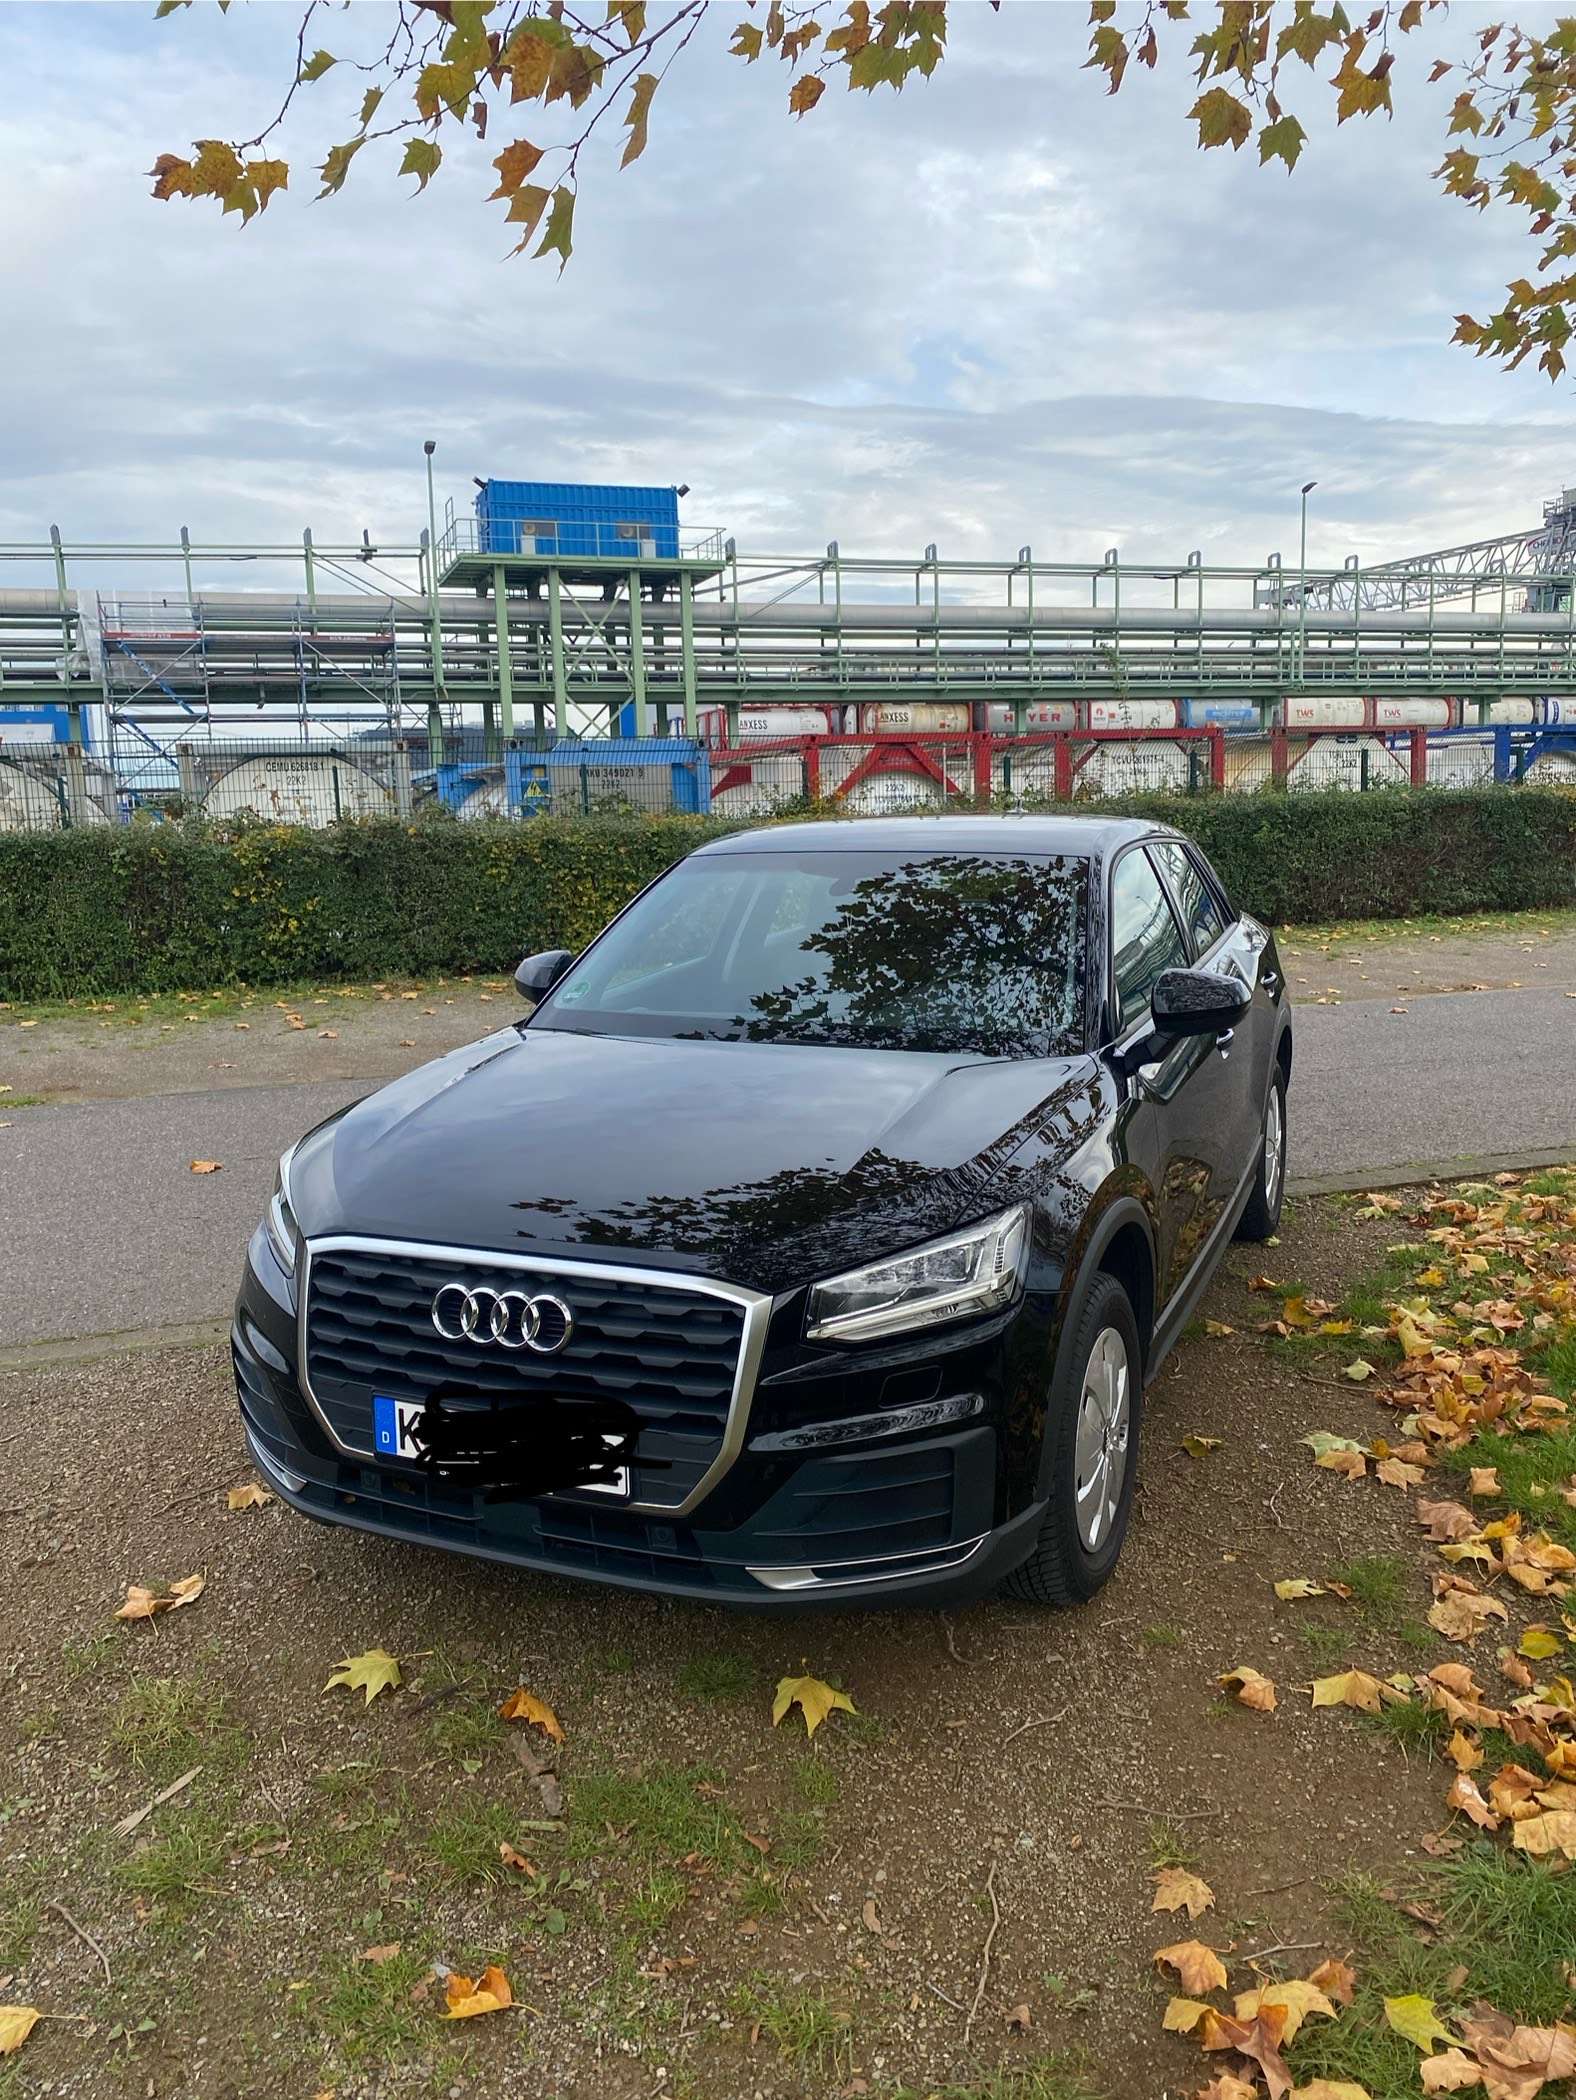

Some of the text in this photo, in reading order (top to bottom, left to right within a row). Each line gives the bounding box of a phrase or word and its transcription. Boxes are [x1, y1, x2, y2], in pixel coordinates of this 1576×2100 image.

[1003, 713, 1061, 723] HYER
[1296, 709, 1315, 718] TWS
[1383, 709, 1401, 718] TWS
[265, 761, 290, 773] CEMU
[381, 1430, 390, 1444] D
